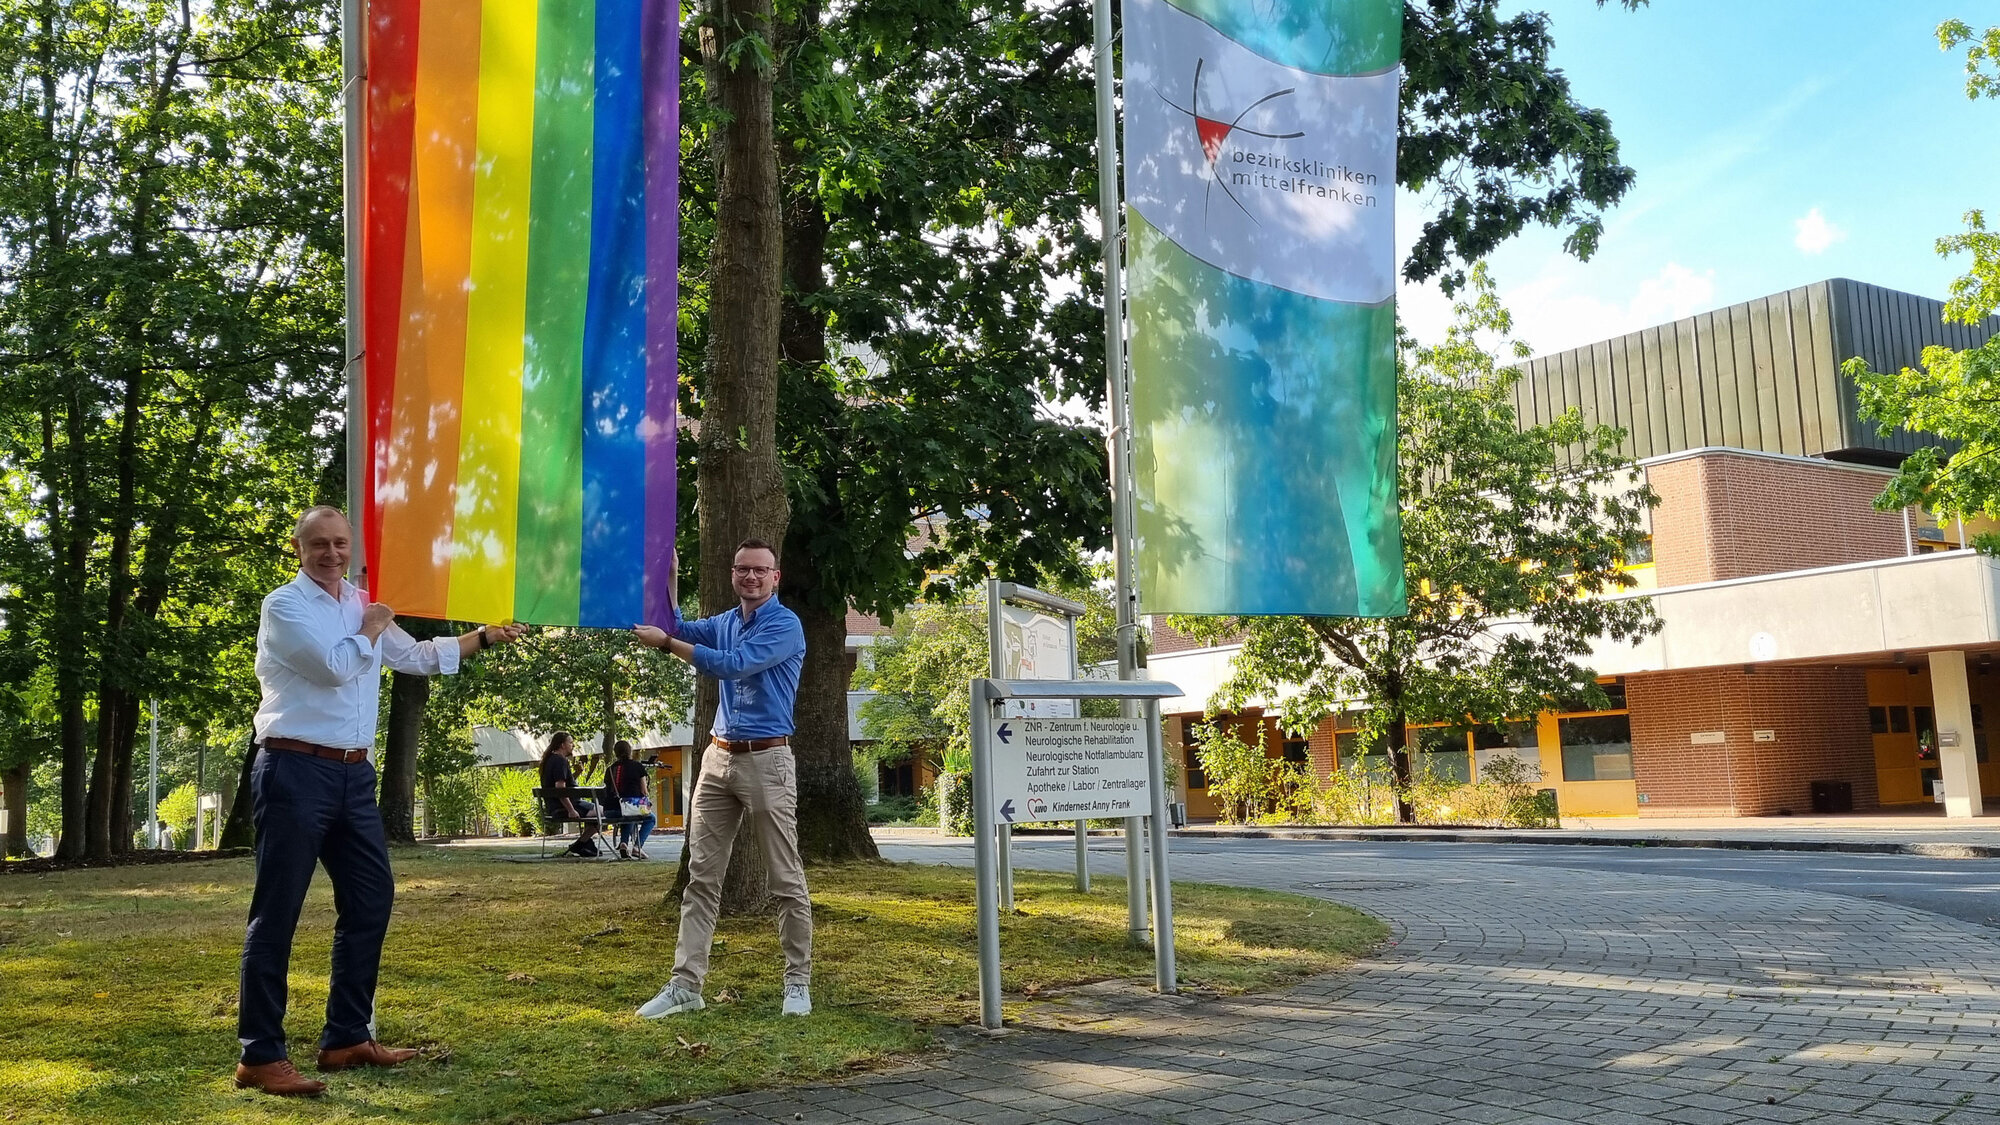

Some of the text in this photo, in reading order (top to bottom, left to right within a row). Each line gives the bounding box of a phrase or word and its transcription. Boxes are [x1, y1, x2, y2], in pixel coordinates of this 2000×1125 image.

[1233, 147, 1377, 186] bezirkskliniken
[1233, 172, 1377, 207] mittelfranken
[1025, 722, 1042, 732] ZNR
[1050, 722, 1081, 732] Zentrum
[1084, 722, 1088, 732] f.
[1091, 722, 1130, 733] Neurologie
[1026, 735, 1134, 748] Neurologische Rehabilitation
[1026, 750, 1144, 763] Neurologische Notfallambulanz
[1027, 766, 1056, 776] Zufahrt
[1072, 765, 1099, 775] Station
[1027, 782, 1066, 794] Apotheke
[1073, 780, 1095, 790] Labor
[1102, 779, 1146, 790] Zentrallager
[1034, 800, 1130, 813] AWO Kindernest Anny Frank
